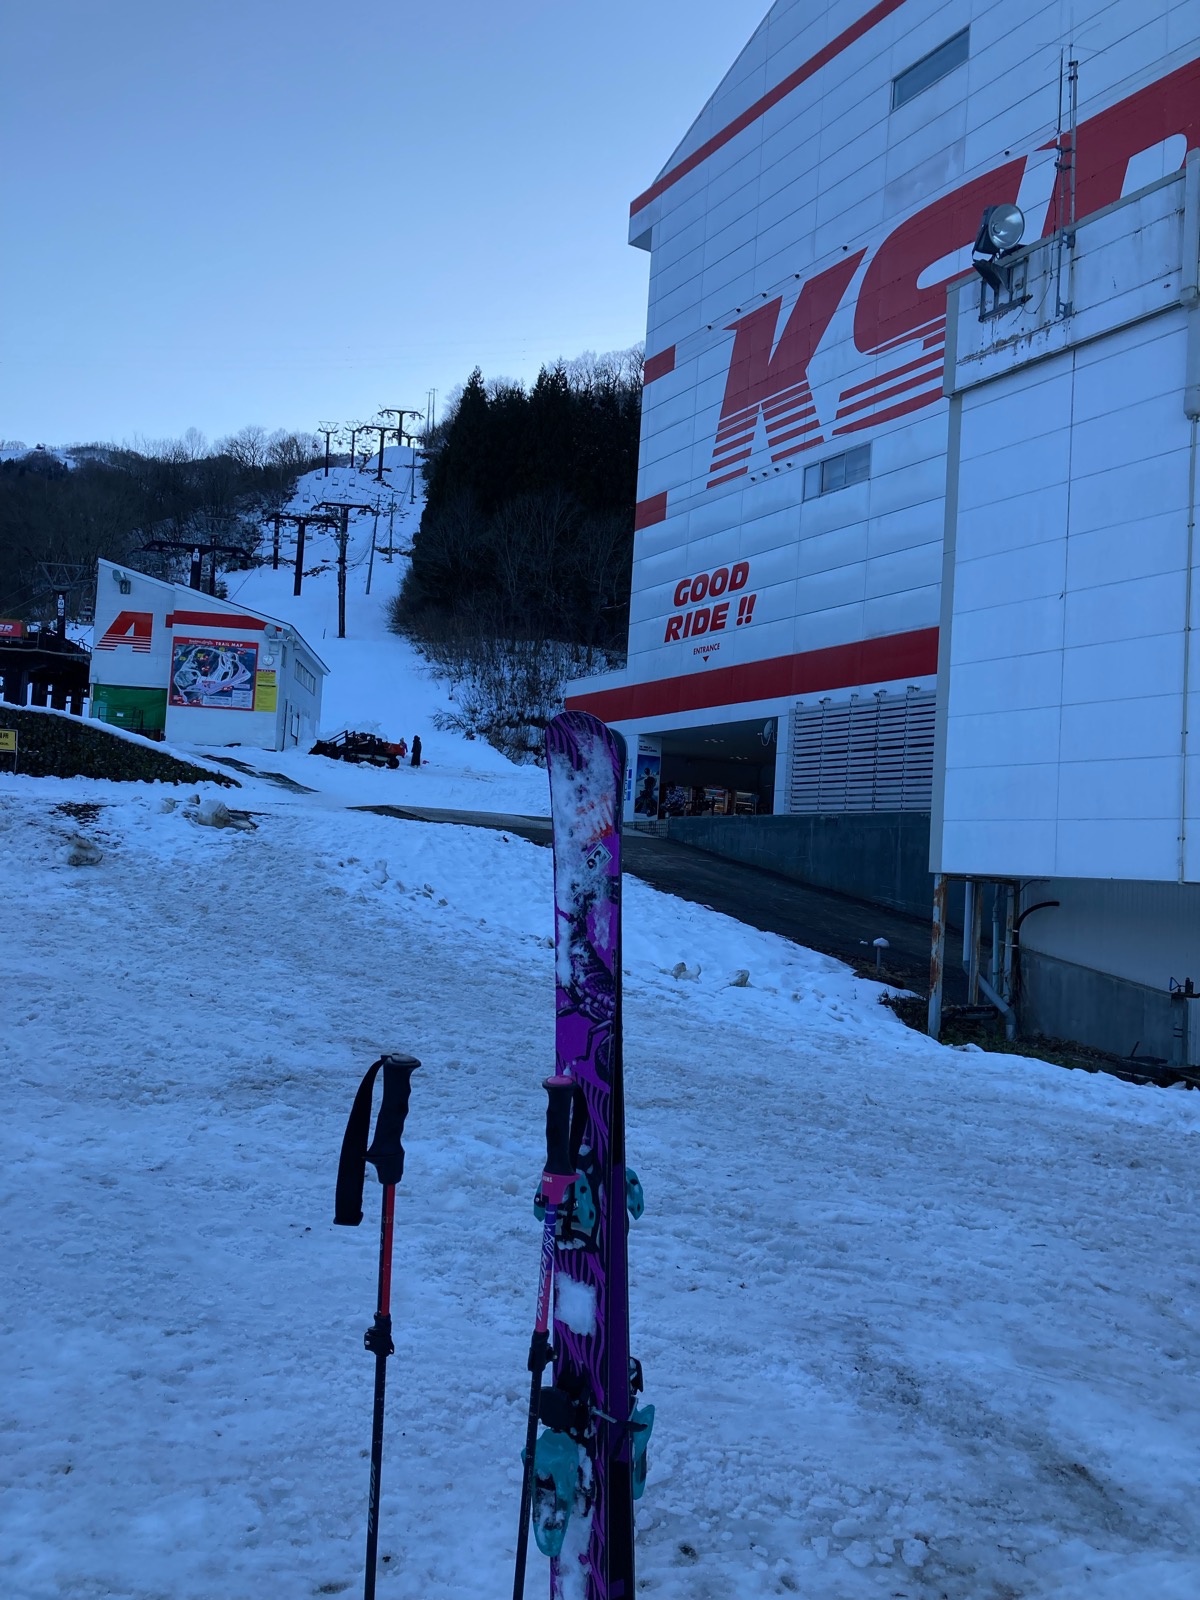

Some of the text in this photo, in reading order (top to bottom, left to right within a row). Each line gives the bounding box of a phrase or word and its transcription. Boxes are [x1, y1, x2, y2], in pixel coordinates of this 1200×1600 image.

[673, 561, 750, 607] GOOD
[663, 601, 730, 644] RIDE
[692, 642, 721, 656] ENTRANCE
[537, 1250, 547, 1322] KIZAKI
